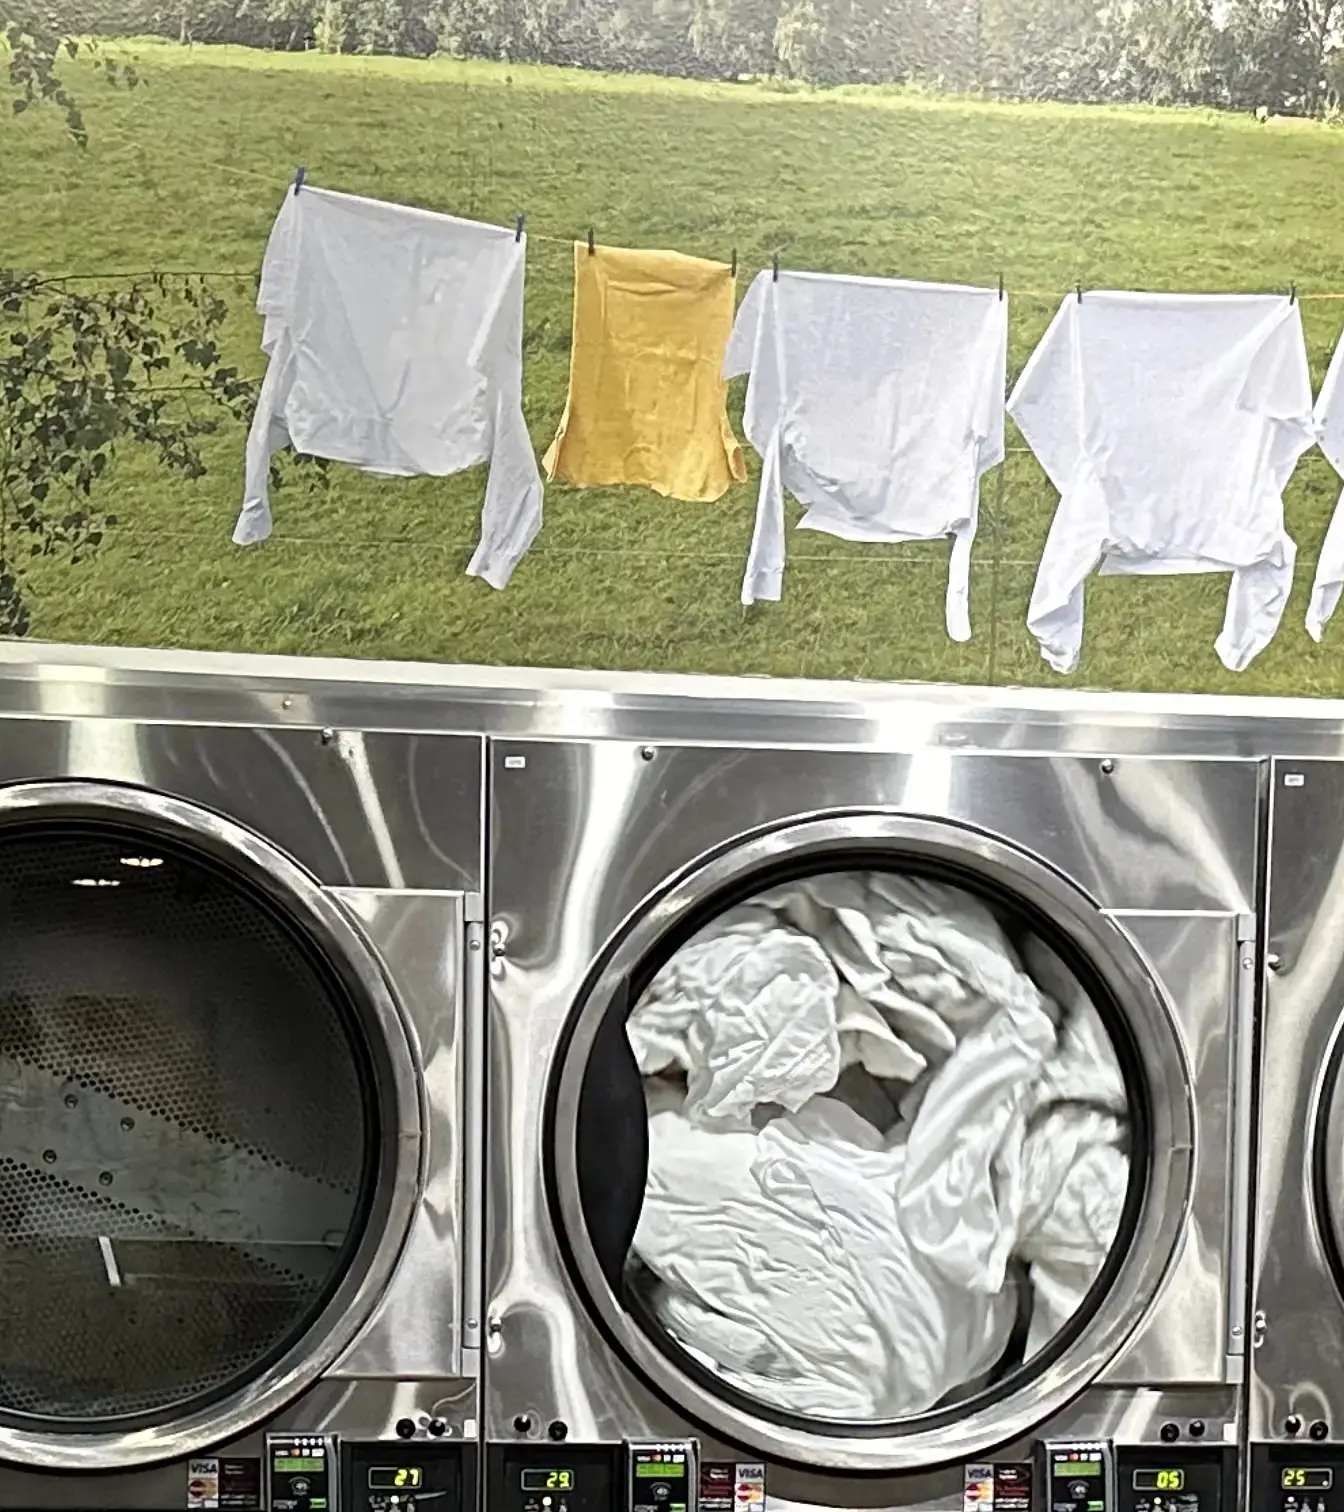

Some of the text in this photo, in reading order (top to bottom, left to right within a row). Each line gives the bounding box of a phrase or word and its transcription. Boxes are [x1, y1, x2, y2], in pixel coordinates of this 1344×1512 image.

[191, 1463, 217, 1474] VISA
[739, 1468, 764, 1478] VISA
[394, 1469, 420, 1485] 27
[546, 1471, 570, 1488] 29
[1156, 1471, 1179, 1488] 05
[1283, 1470, 1306, 1487] 25
